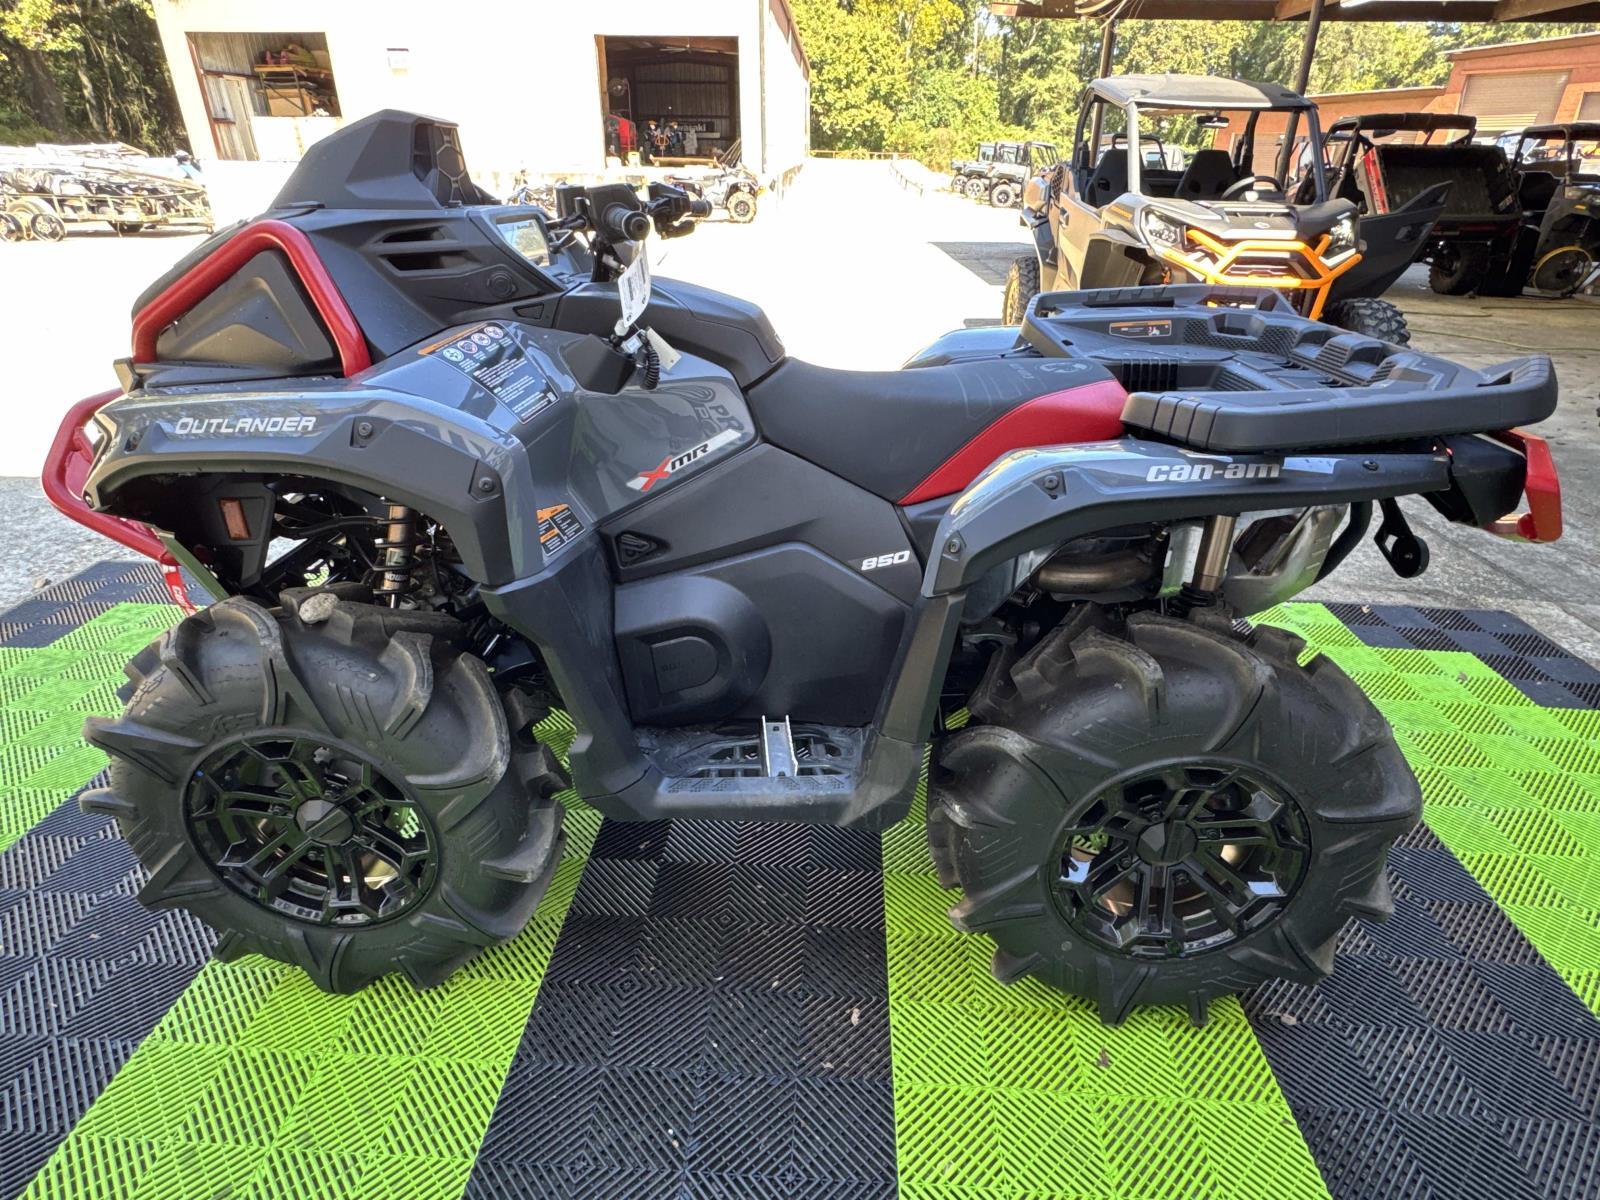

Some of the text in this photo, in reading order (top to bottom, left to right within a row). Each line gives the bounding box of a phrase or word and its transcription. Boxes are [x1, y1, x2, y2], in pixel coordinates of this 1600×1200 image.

[174, 416, 317, 435] OUTLANDER
[1146, 463, 1281, 483] can-am
[861, 550, 911, 571] 850
